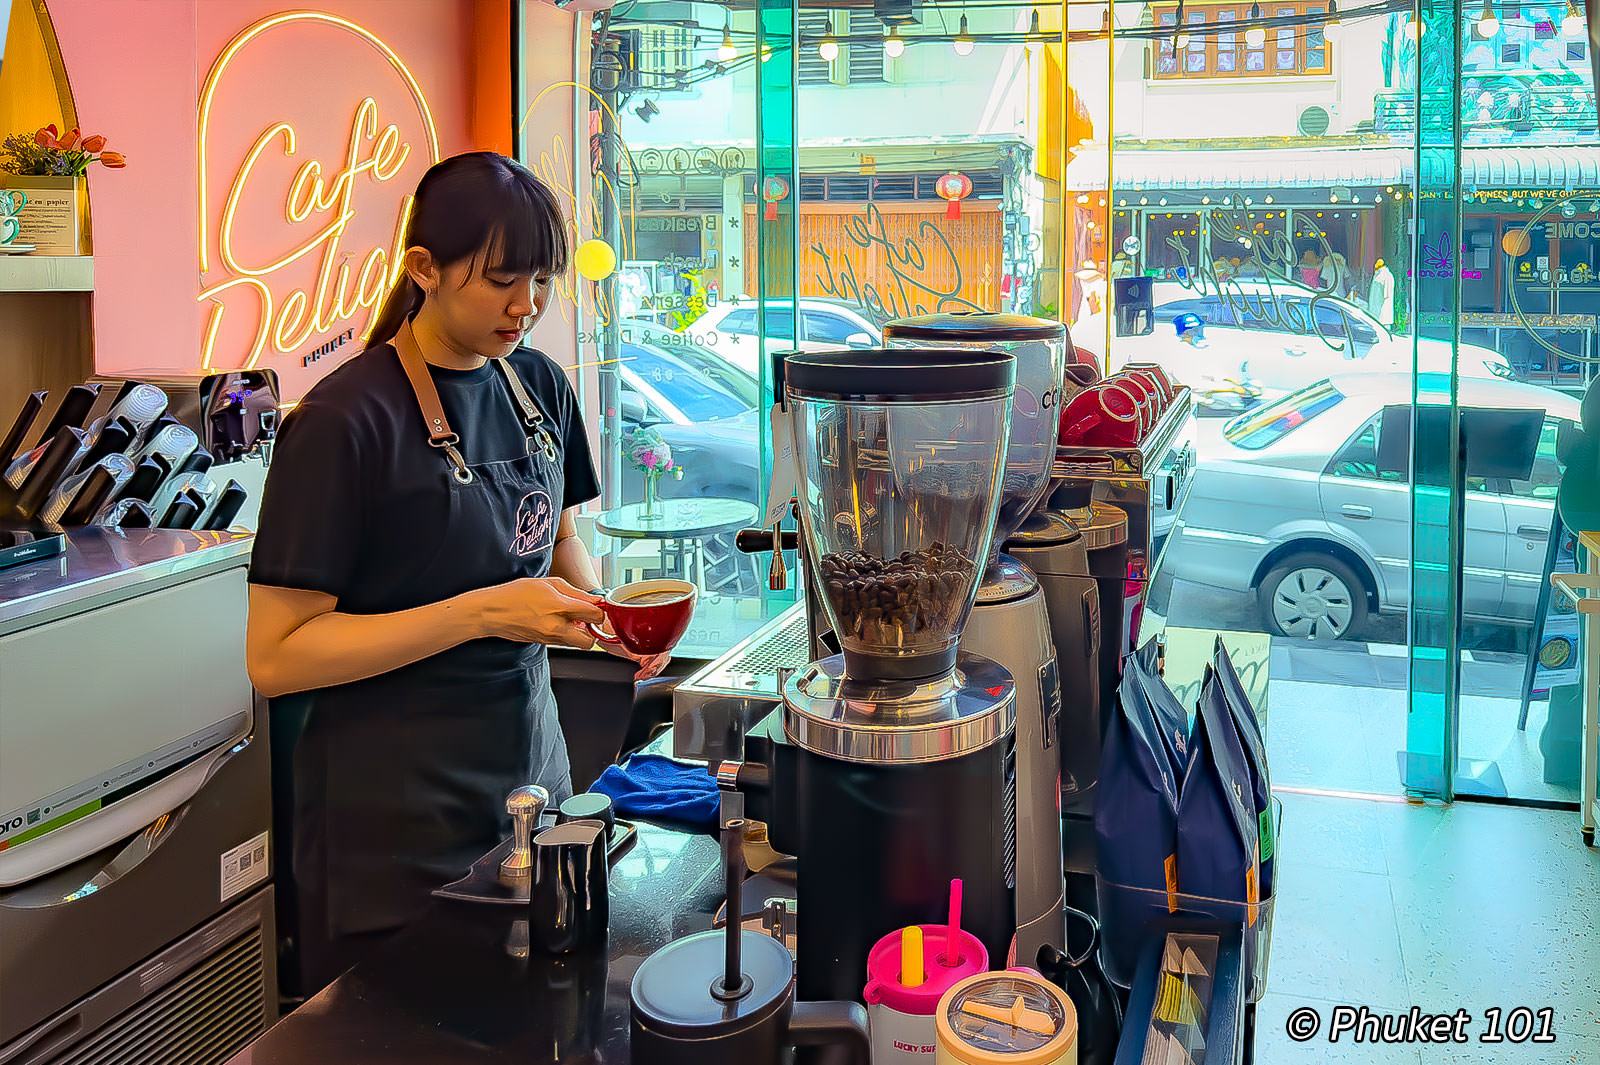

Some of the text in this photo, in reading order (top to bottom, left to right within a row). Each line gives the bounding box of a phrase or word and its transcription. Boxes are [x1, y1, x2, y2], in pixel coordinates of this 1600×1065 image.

[219, 97, 411, 276] Cafe
[196, 194, 415, 372] Deligh
[893, 1040, 918, 1053] LUCKY
